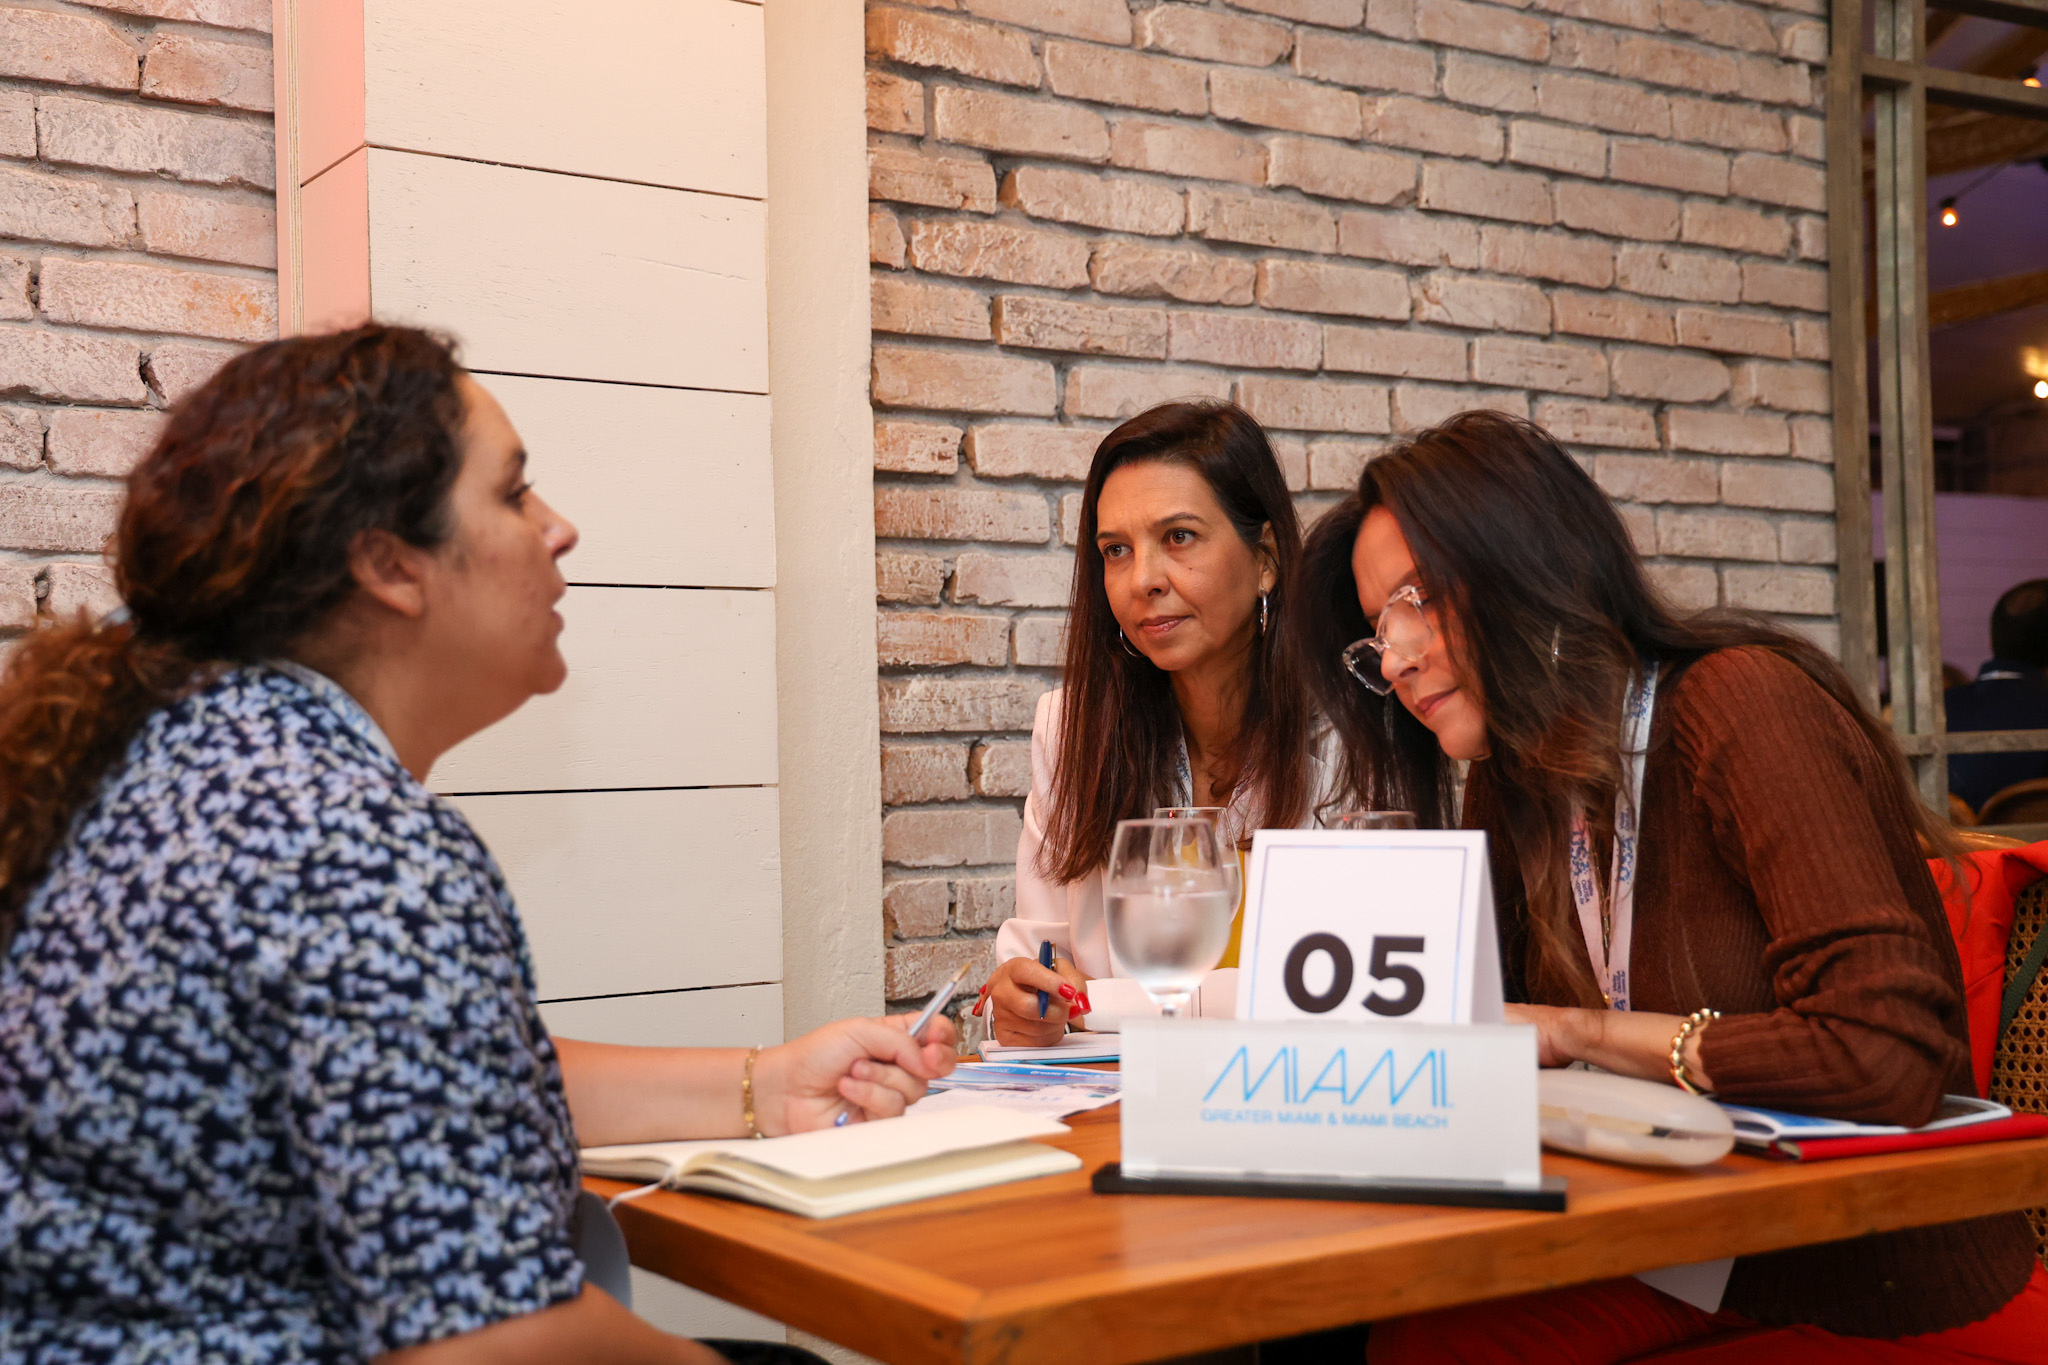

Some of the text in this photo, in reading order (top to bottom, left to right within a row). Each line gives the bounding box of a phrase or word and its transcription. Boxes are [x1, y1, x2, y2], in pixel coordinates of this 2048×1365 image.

[1283, 931, 1427, 1017] 05
[1202, 1045, 1447, 1108] MIAMI
[1200, 1109, 1448, 1129] GREATER MIAMI & MIAMI BEACH
